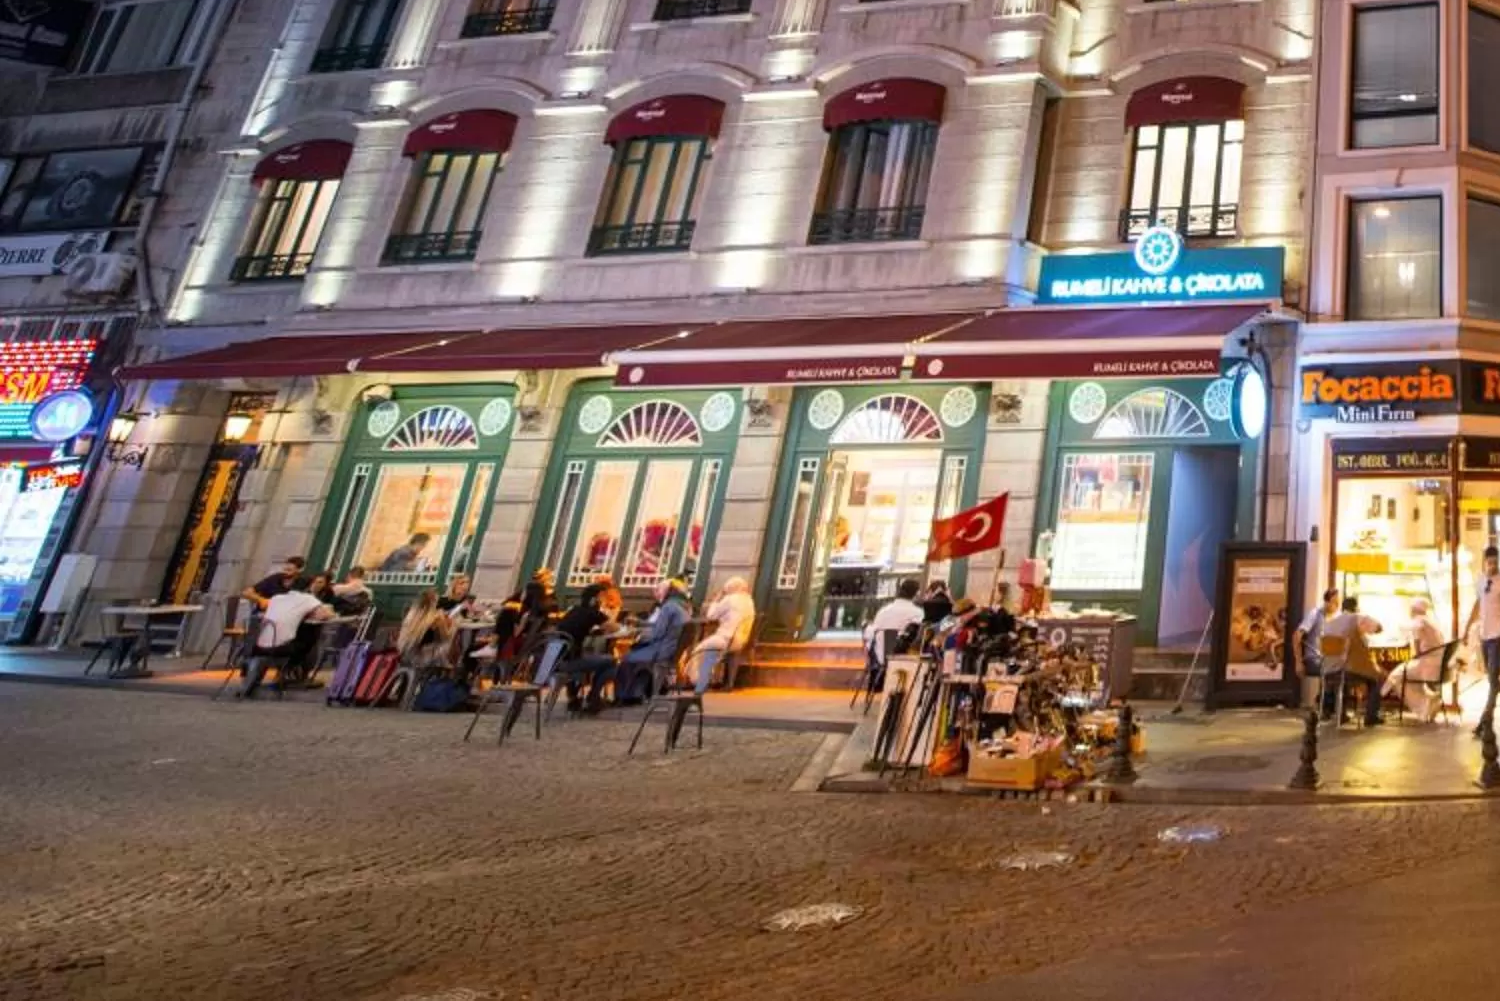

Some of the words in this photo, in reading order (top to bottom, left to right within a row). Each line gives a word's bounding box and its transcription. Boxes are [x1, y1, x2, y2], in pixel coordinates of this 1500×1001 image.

[1112, 276, 1168, 295] KAHVE
[1169, 275, 1182, 293] &
[0, 372, 50, 403] SM
[1301, 365, 1454, 404] Focaccia
[1337, 405, 1375, 422] Mini
